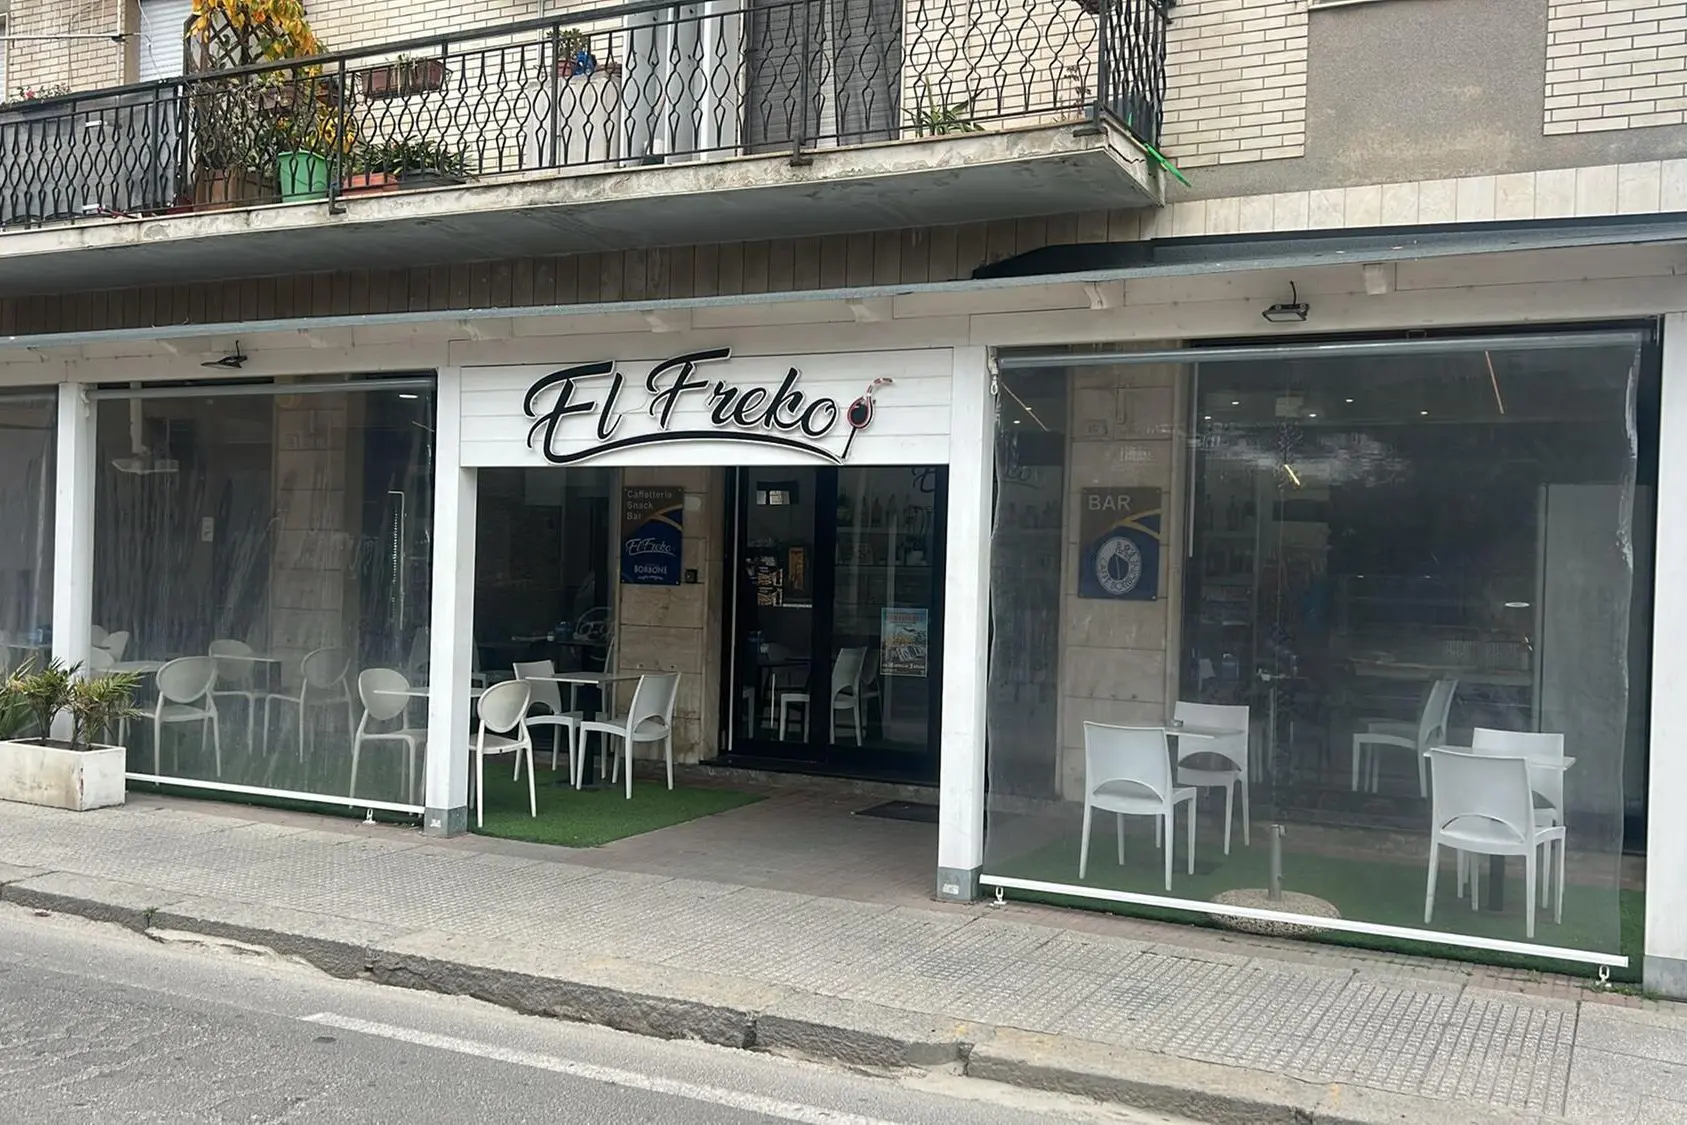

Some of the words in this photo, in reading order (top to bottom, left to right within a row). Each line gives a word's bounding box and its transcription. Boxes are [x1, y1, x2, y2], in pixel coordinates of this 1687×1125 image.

[523, 360, 624, 464] El
[645, 346, 840, 439] Freko
[627, 501, 653, 510] Snack
[1088, 494, 1131, 511] BAR
[626, 511, 641, 520] Bar
[634, 564, 668, 574] BORBONE
